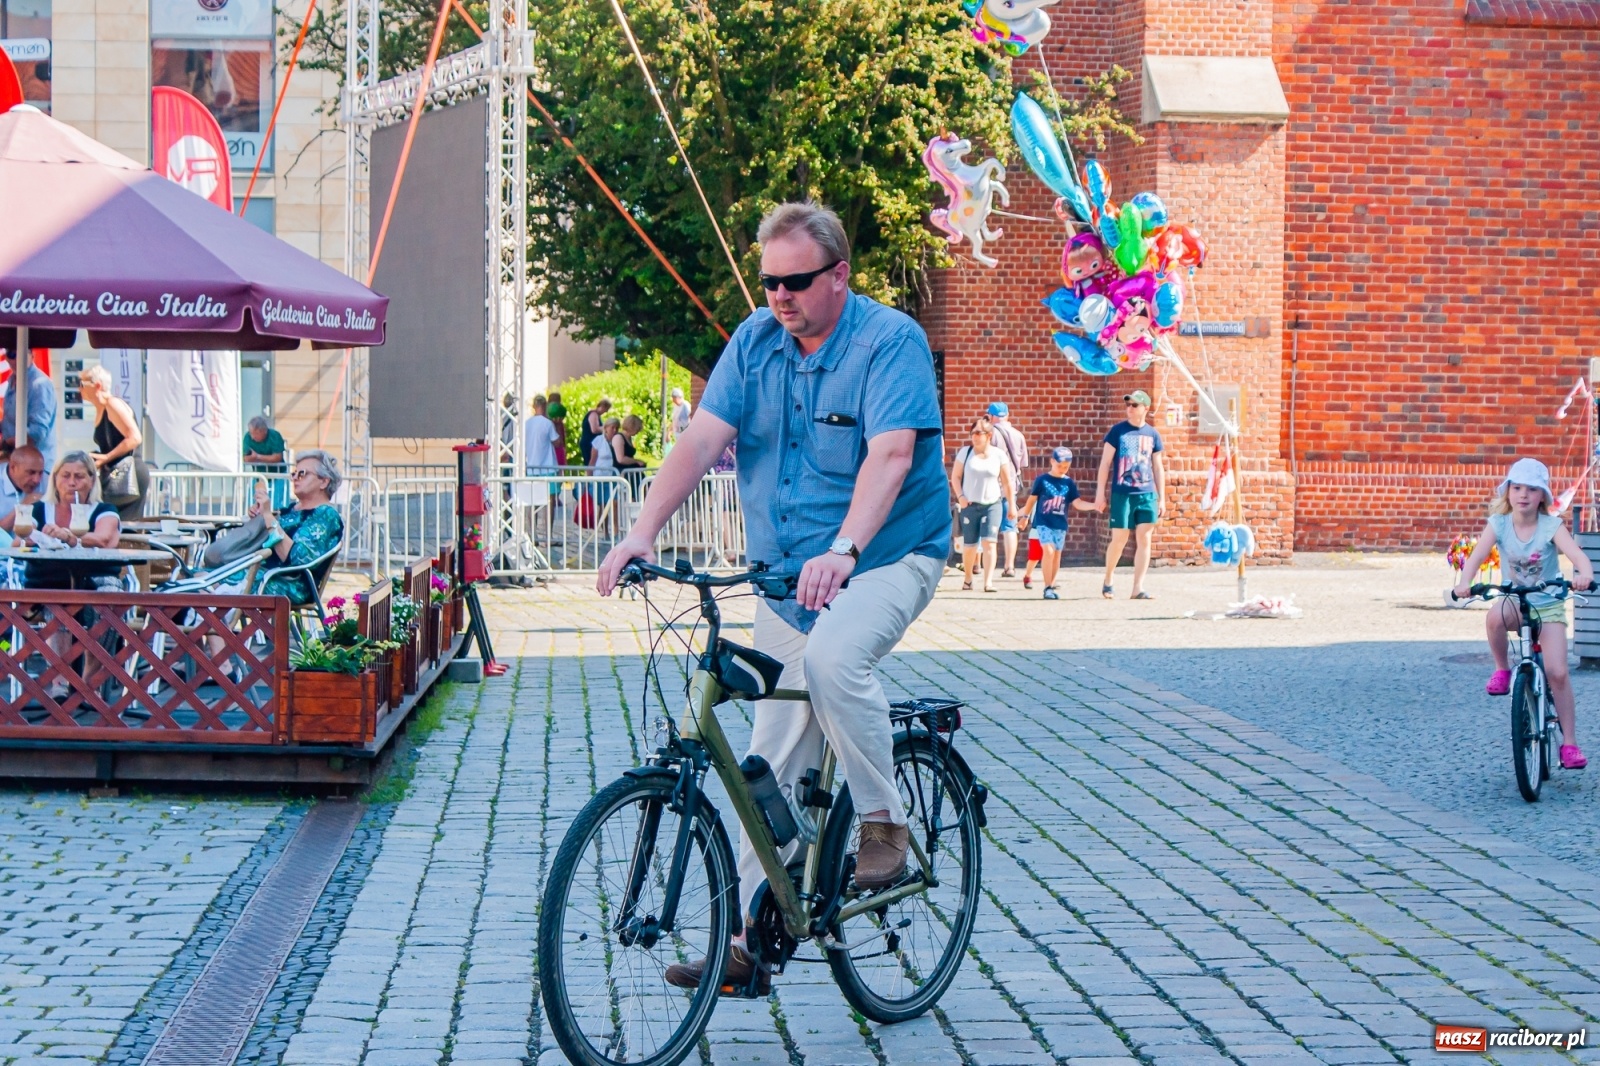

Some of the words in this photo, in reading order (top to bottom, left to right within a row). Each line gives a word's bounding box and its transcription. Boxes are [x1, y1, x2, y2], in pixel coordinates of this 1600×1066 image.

[0, 289, 90, 315] elateria
[97, 291, 149, 316] Ciao
[156, 293, 228, 317] Italia
[262, 298, 314, 328] Gelateria
[316, 305, 341, 328] Ciao
[344, 307, 376, 331] Italia
[1198, 323, 1244, 333] ominikański
